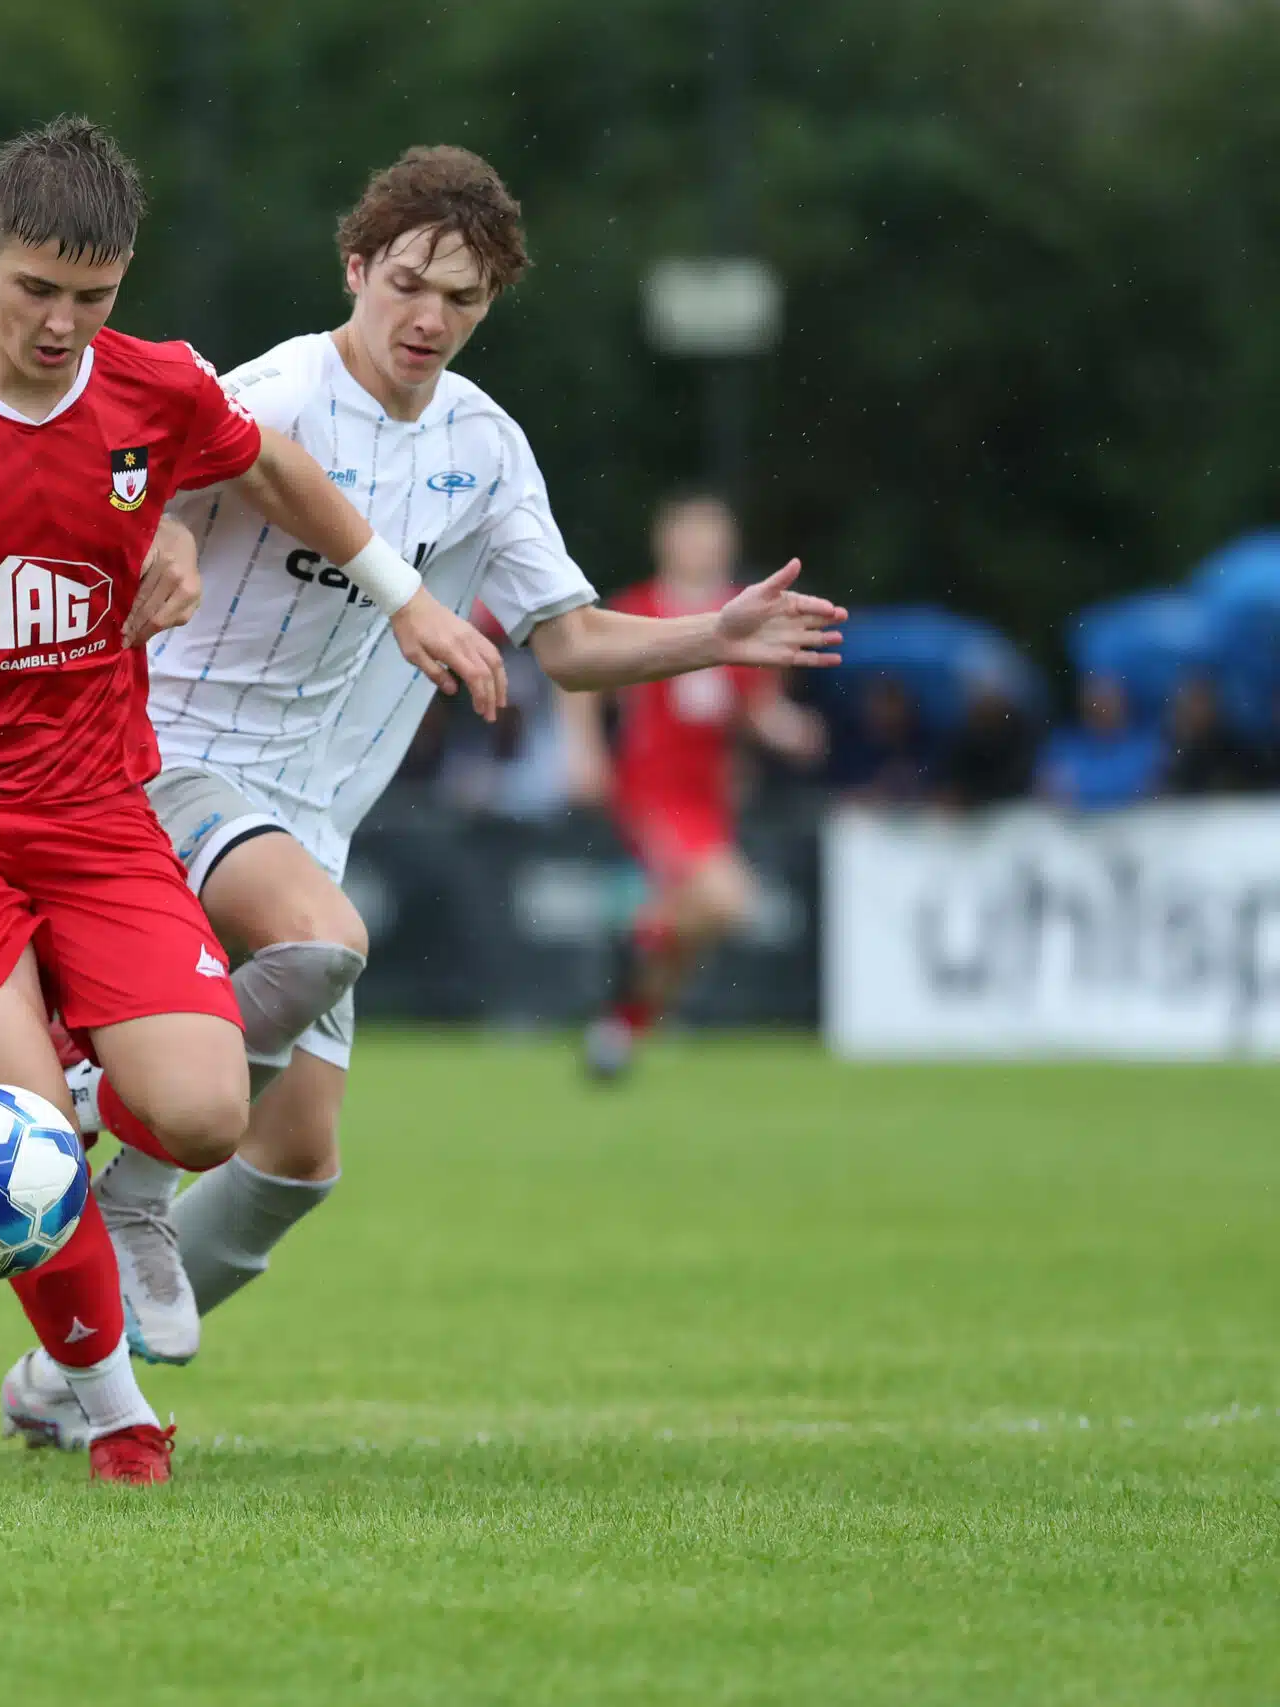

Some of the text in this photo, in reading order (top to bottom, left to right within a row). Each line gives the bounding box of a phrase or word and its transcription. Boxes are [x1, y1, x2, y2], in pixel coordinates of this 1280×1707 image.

[0, 653, 58, 671] GAMBLE
[69, 647, 86, 660] CO
[87, 639, 107, 655] LTD
